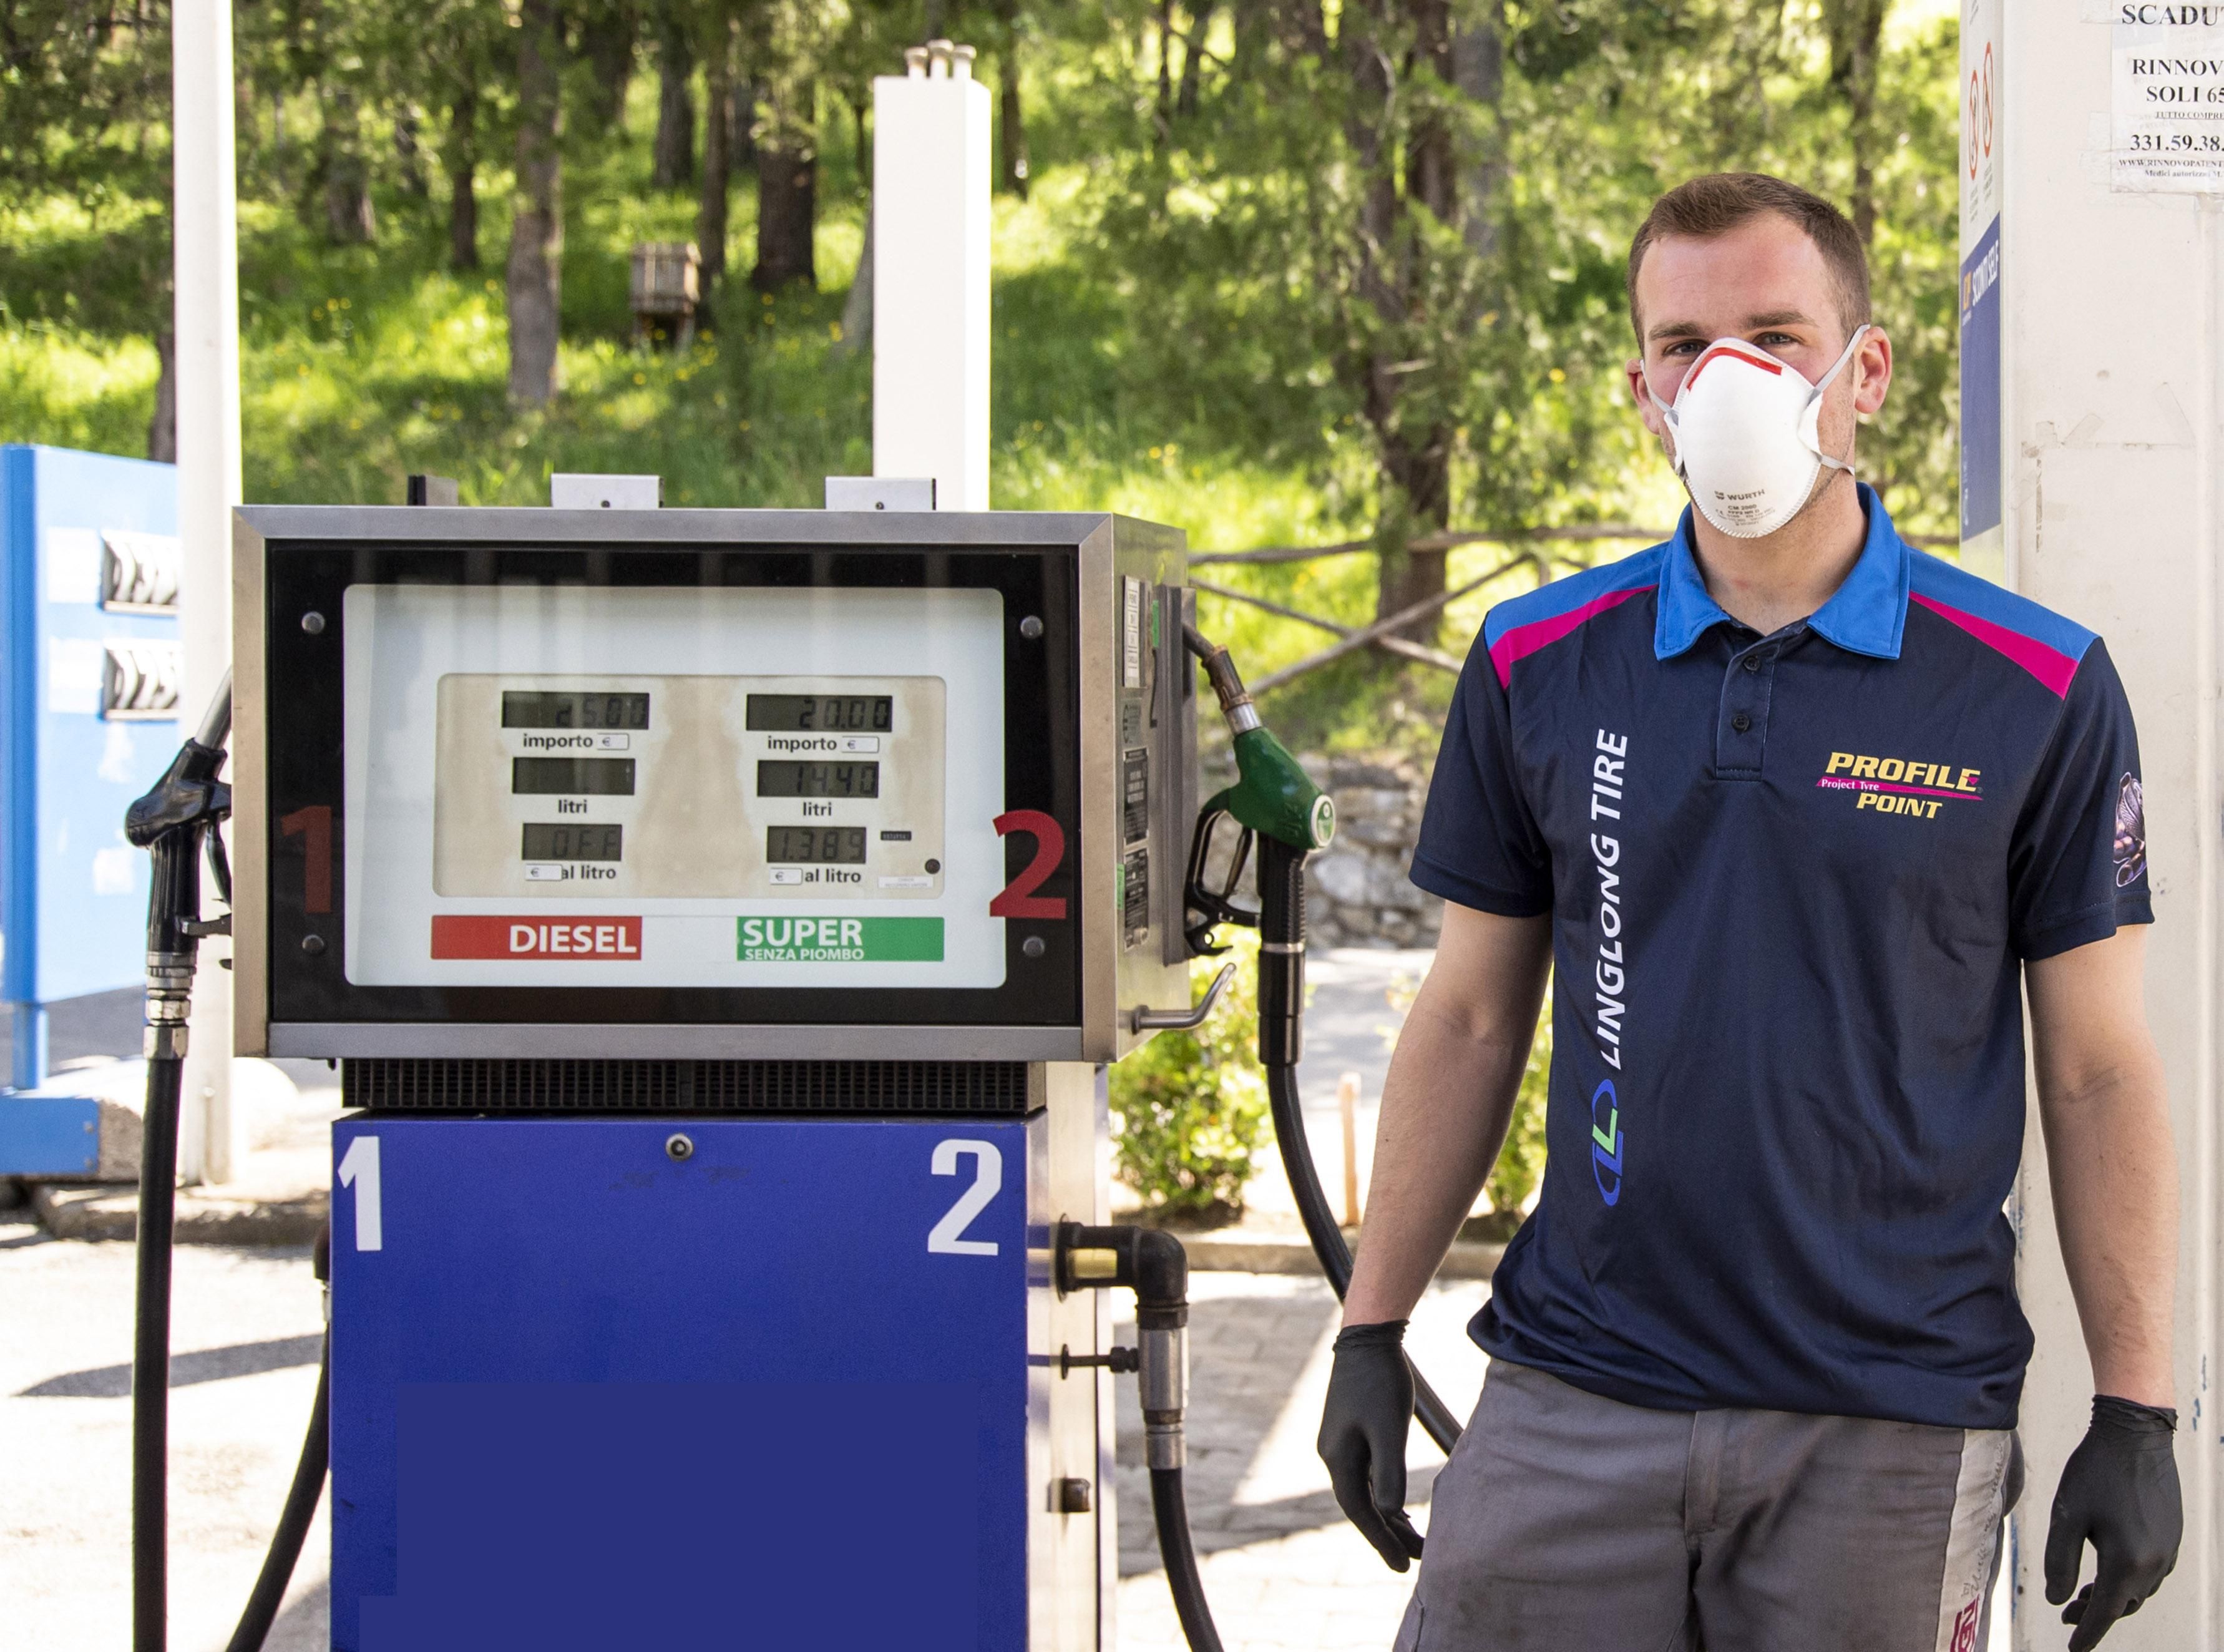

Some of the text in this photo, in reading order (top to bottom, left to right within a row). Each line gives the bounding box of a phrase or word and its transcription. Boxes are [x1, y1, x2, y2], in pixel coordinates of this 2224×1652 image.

[2122, 4, 2224, 26] SCADU
[2146, 86, 2199, 103] SOLI
[2155, 111, 2185, 119] TUTTO
[2130, 134, 2224, 152] 331.59.38.
[2119, 159, 2224, 168] WWW.RINNOVOPATENT
[2145, 169, 2170, 177] Medici
[799, 698, 890, 730] 20.00
[523, 733, 593, 750] importo
[767, 736, 837, 753] importo
[1825, 751, 1981, 792] PROFILE
[1821, 779, 1880, 792] Project Tyre
[557, 798, 588, 813] litri
[802, 801, 832, 816] litri
[1856, 793, 1943, 819] POINT
[280, 804, 333, 914] 1
[989, 808, 1067, 920] 2
[562, 865, 574, 880] al
[580, 865, 617, 880] litro
[804, 868, 819, 883] al
[826, 868, 862, 883] litro
[1591, 728, 1628, 1070] LINGLONG TIRE
[509, 924, 637, 954] DIESEL
[742, 919, 864, 947] SUPER
[744, 948, 865, 961] SENZA PIOMBO
[337, 1135, 383, 1252] 1
[927, 1138, 1003, 1256] 2
